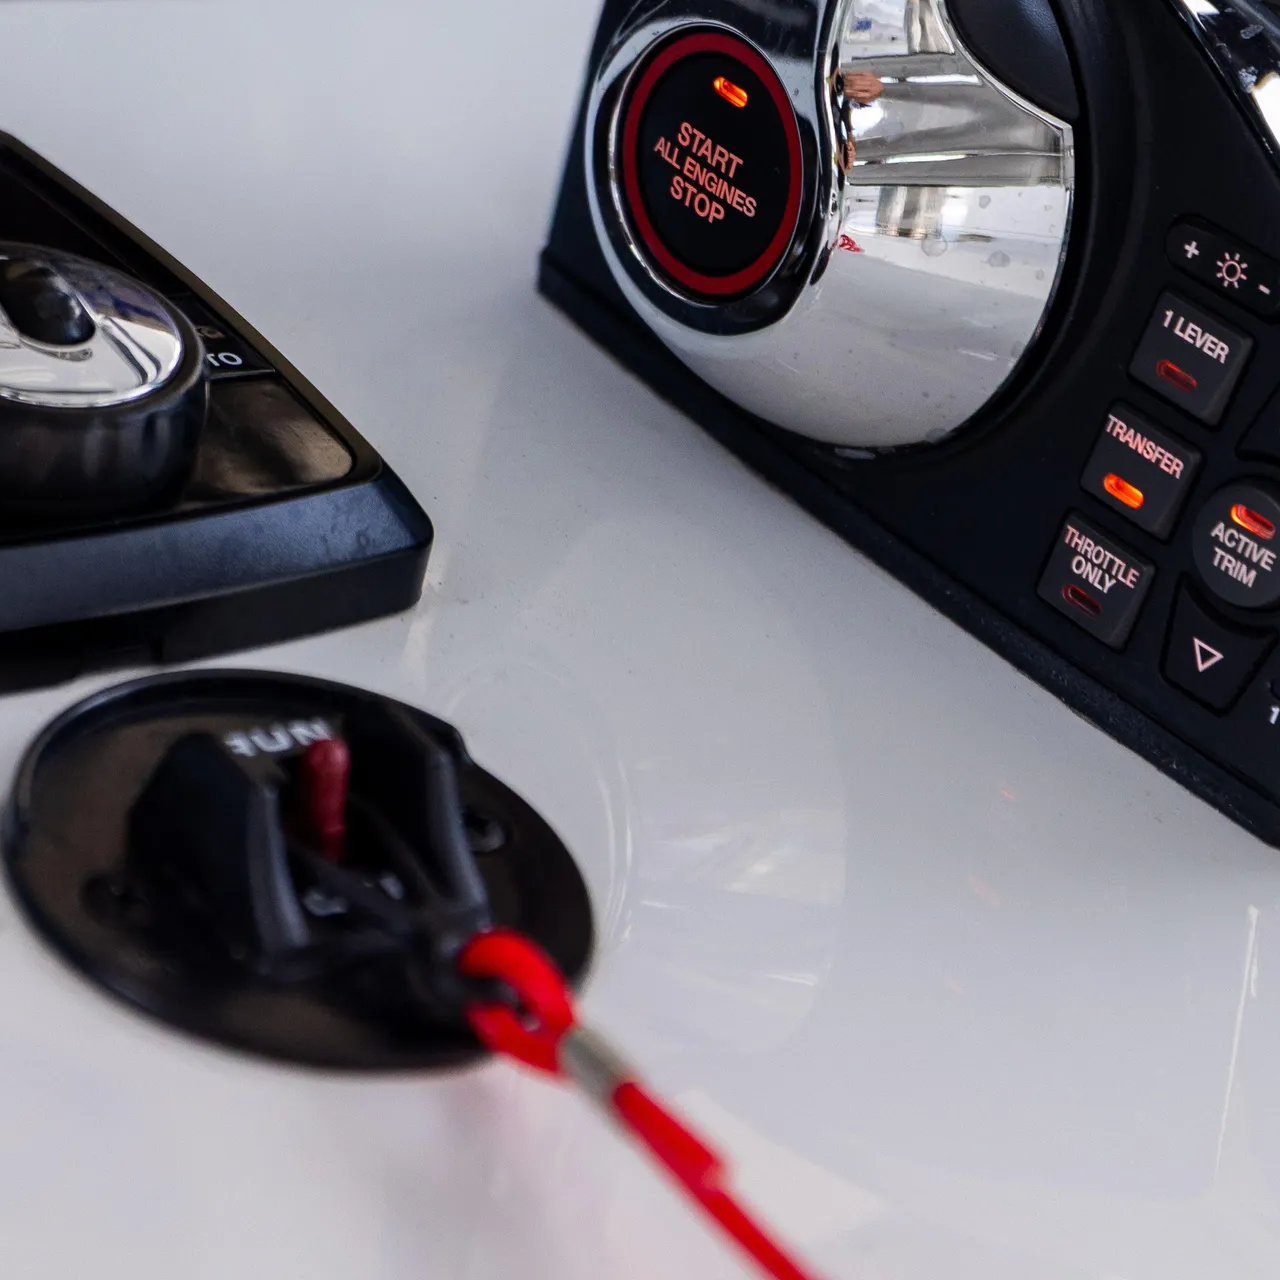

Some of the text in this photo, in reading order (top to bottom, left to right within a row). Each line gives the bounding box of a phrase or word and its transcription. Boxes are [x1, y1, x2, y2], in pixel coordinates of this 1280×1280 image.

[653, 136, 757, 218] ALL ENGINES
[677, 122, 744, 179] START
[670, 176, 725, 224] STOP
[1163, 309, 1230, 364] 1 LEVER
[1105, 413, 1185, 480] TRANSFER
[1064, 524, 1140, 589] THROTTLE
[1210, 521, 1277, 572] ACTIVE
[1213, 548, 1257, 588] TRIM
[1071, 555, 1117, 594] ONLY
[1269, 706, 1280, 725] 1
